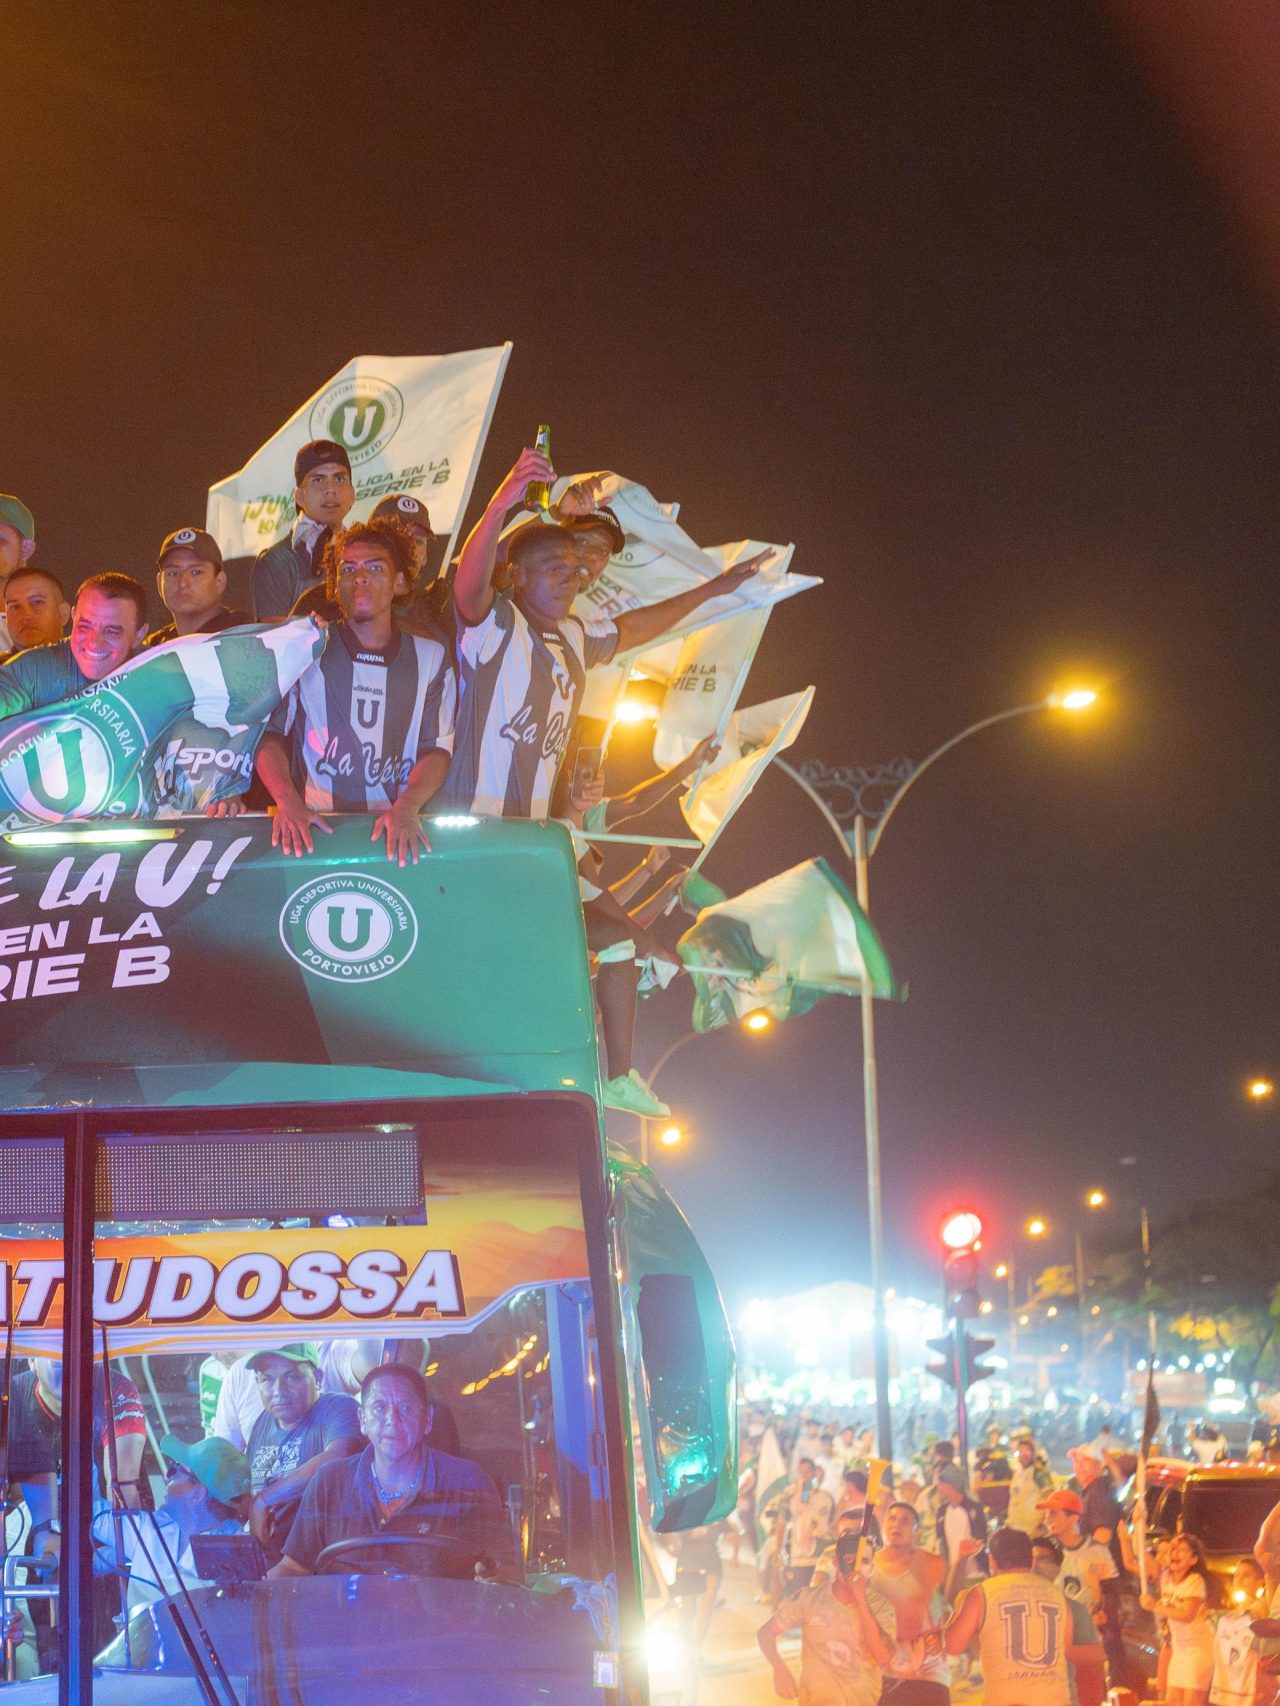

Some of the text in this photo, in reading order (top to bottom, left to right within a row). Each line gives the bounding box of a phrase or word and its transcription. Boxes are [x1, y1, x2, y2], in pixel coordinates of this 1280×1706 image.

[343, 405, 377, 446] U
[356, 470, 451, 501] SERIE B
[357, 457, 450, 488] LIGA EN LA
[700, 664, 716, 673] LA
[703, 678, 716, 691] B
[86, 698, 136, 758] RSITARIA
[357, 698, 380, 729] U
[503, 705, 538, 744] La
[23, 727, 88, 819] U
[317, 735, 355, 778] La
[39, 853, 120, 910] LA
[135, 836, 252, 908] U!
[290, 879, 408, 931] LIGA DEPORTIVA UNIVERSITARIA
[88, 912, 163, 945] LA
[326, 906, 373, 952] U
[112, 945, 171, 989] B
[302, 948, 396, 977] PORTOVIEJO
[1000, 1601, 1061, 1669] U
